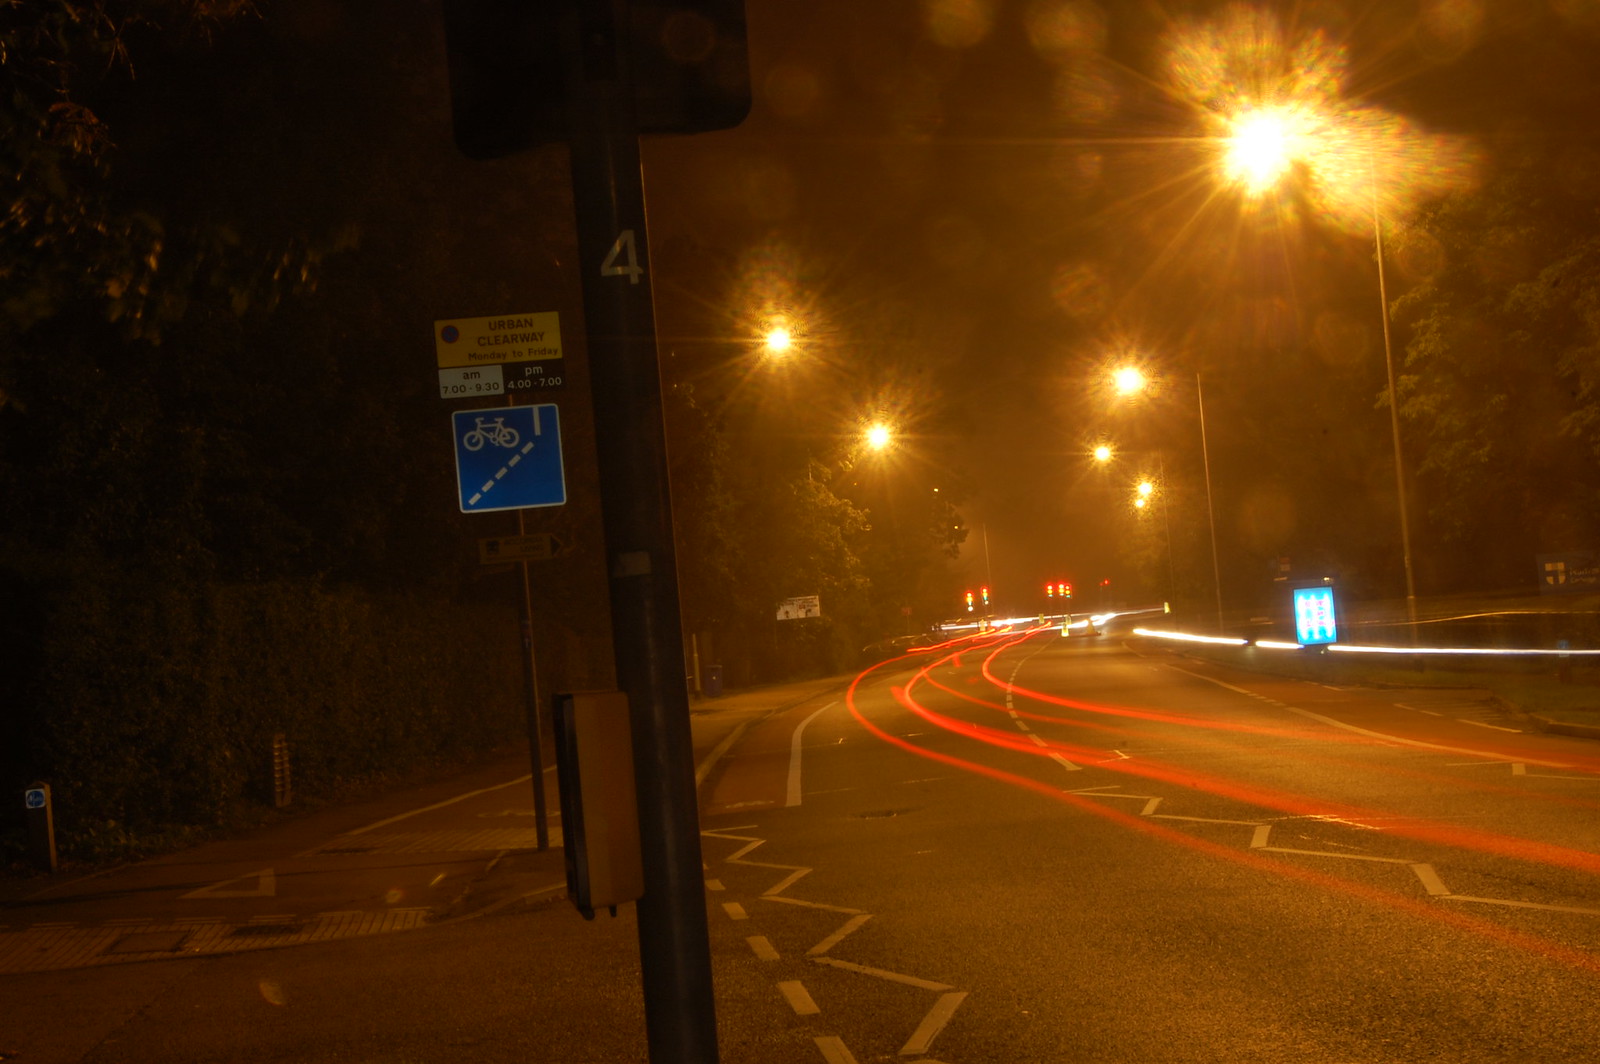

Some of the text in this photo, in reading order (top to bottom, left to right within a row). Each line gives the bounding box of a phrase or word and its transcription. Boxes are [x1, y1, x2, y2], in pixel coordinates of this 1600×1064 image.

[600, 229, 644, 285] 4
[488, 318, 533, 331] URBAN
[477, 331, 545, 347] CLEARWAY
[468, 346, 558, 361] Monday to Friday
[463, 370, 481, 380] am
[524, 365, 543, 377] pm
